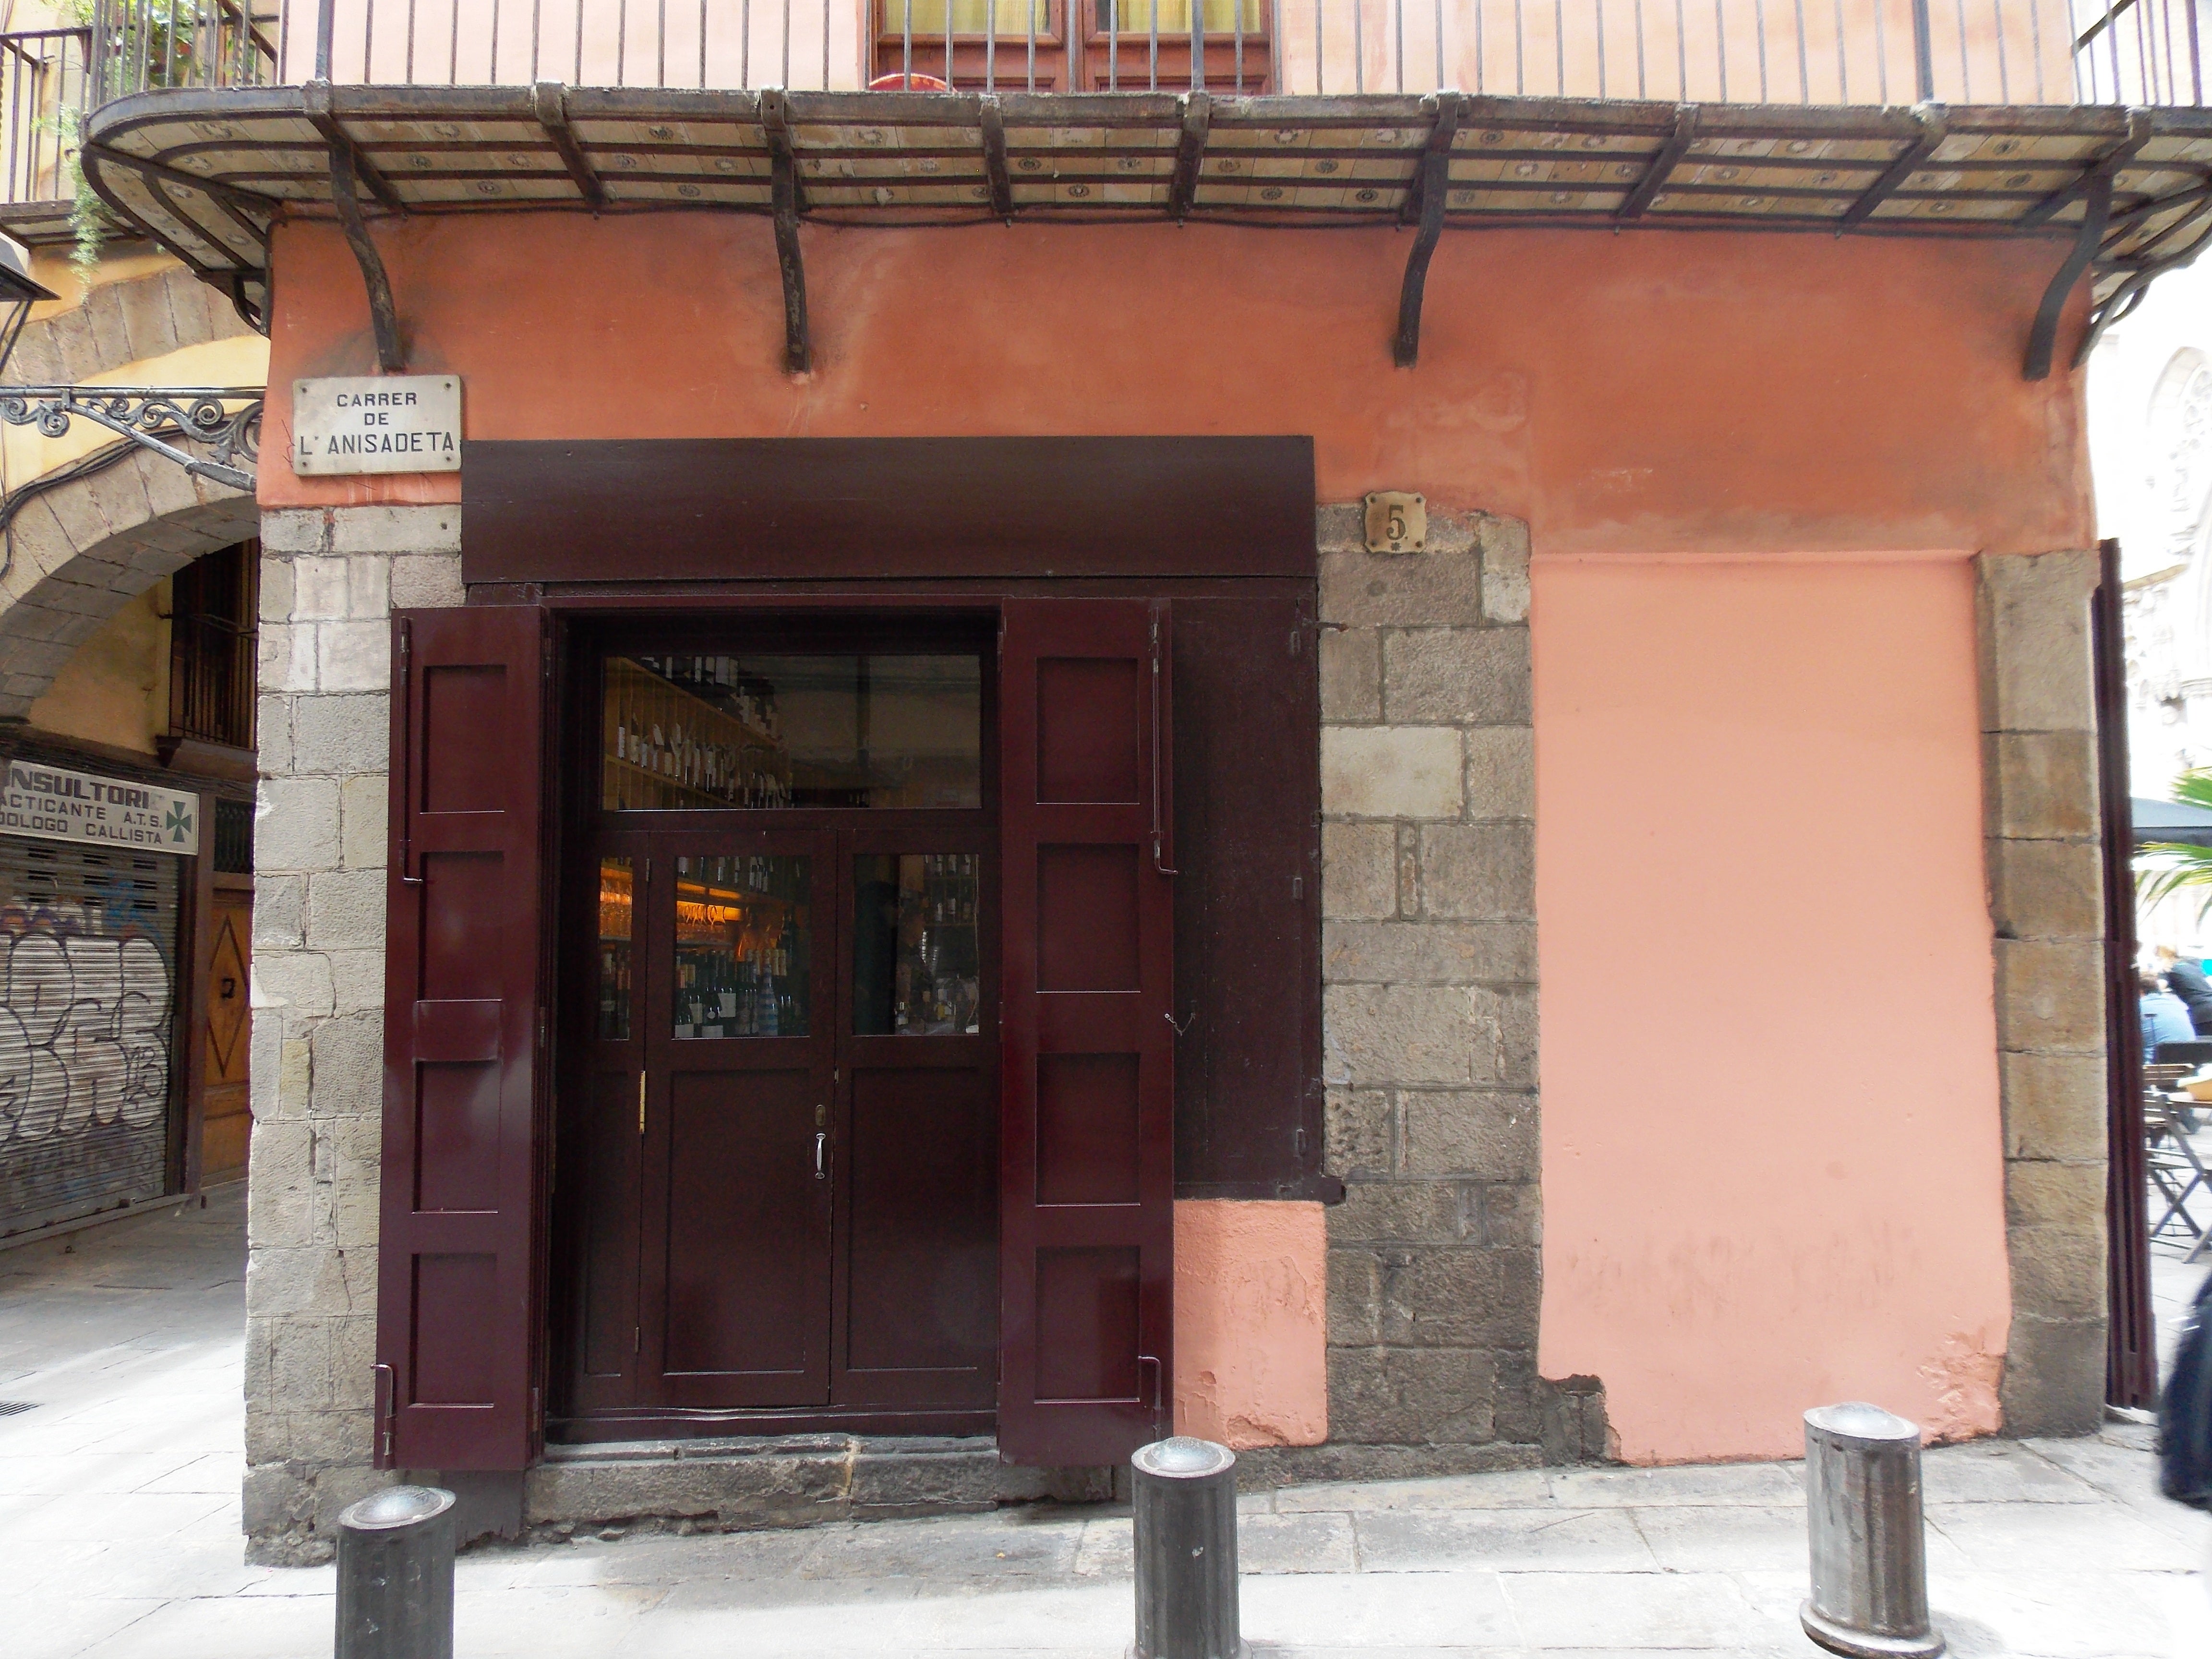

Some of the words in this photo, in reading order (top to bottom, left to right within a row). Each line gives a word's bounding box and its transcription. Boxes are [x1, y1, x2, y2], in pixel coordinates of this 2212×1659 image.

[337, 392, 417, 408] CARRER
[364, 412, 389, 426] DE
[11, 767, 165, 810] NSULTORI
[85, 823, 162, 845] CALLISTA
